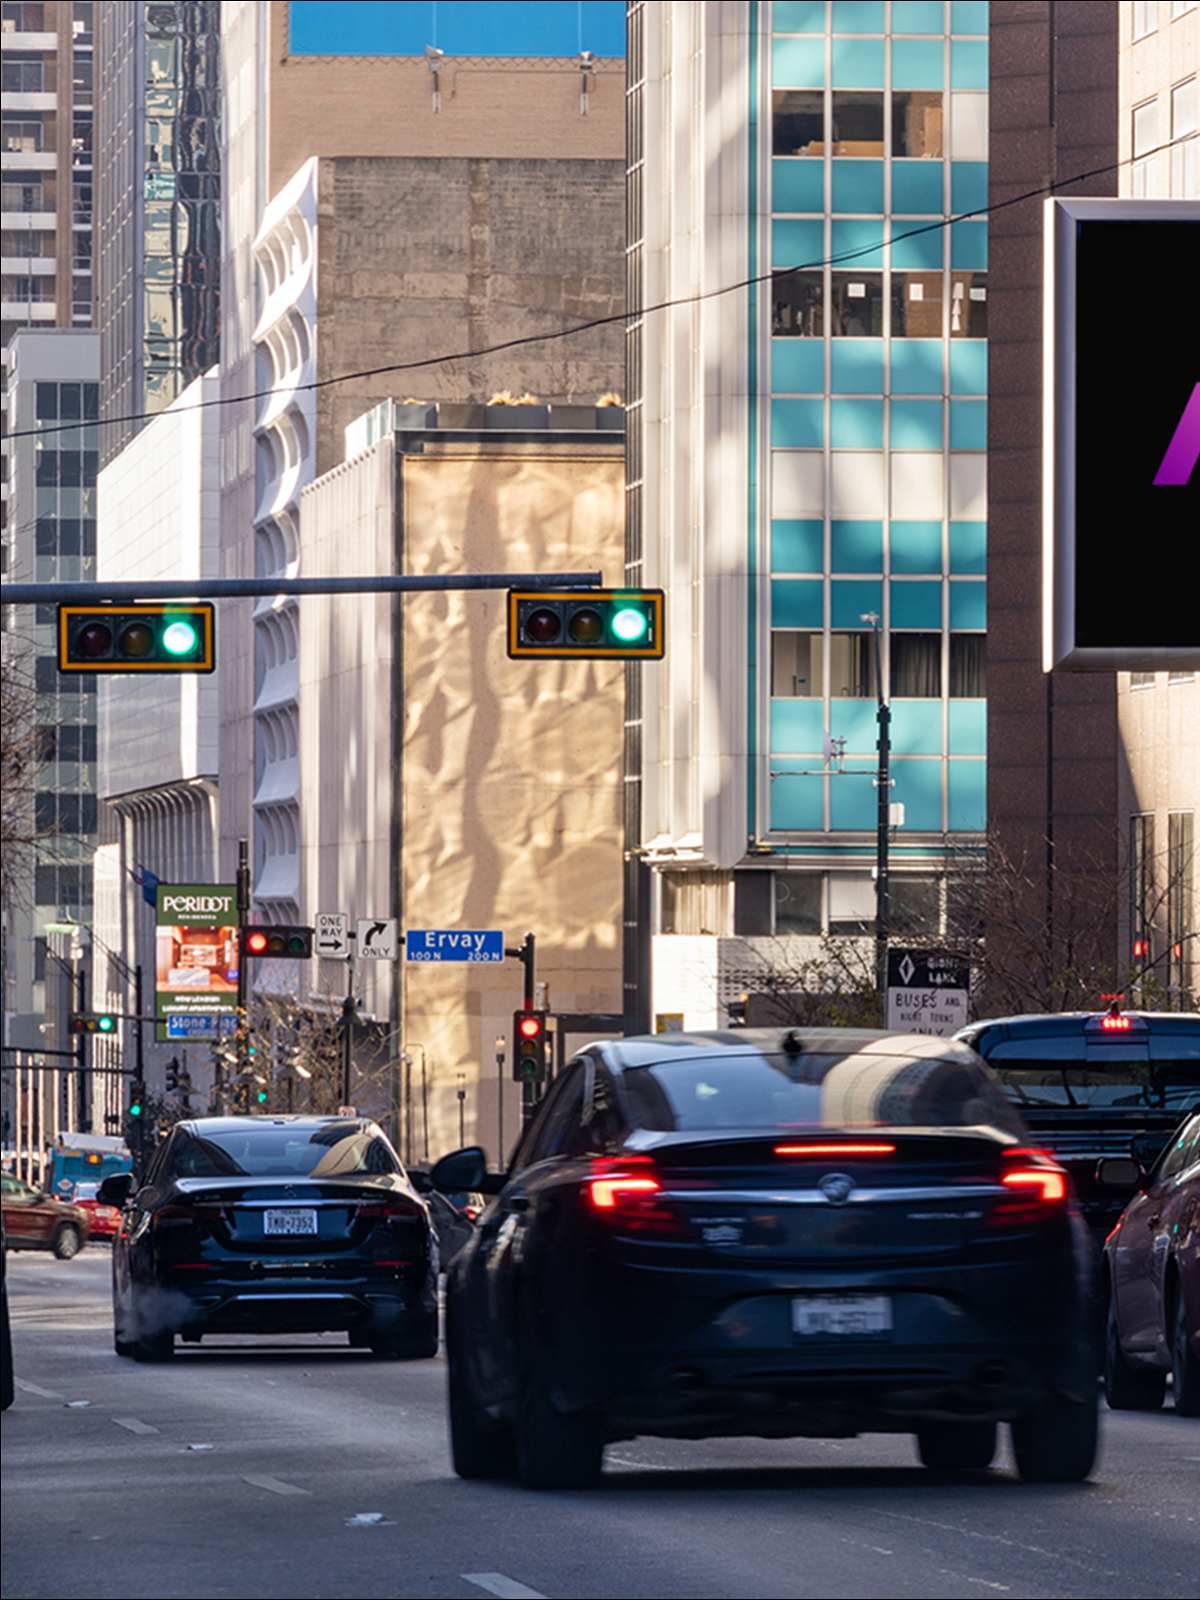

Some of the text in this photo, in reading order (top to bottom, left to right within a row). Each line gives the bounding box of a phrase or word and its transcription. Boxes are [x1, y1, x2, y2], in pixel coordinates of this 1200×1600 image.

[163, 896, 233, 912] PERIDOT
[320, 916, 342, 926] ONE
[321, 928, 343, 937] WAY
[425, 932, 485, 952] Ervay
[362, 947, 390, 957] ONLY
[896, 993, 937, 1008] BUSES
[171, 1017, 206, 1028] Stone
